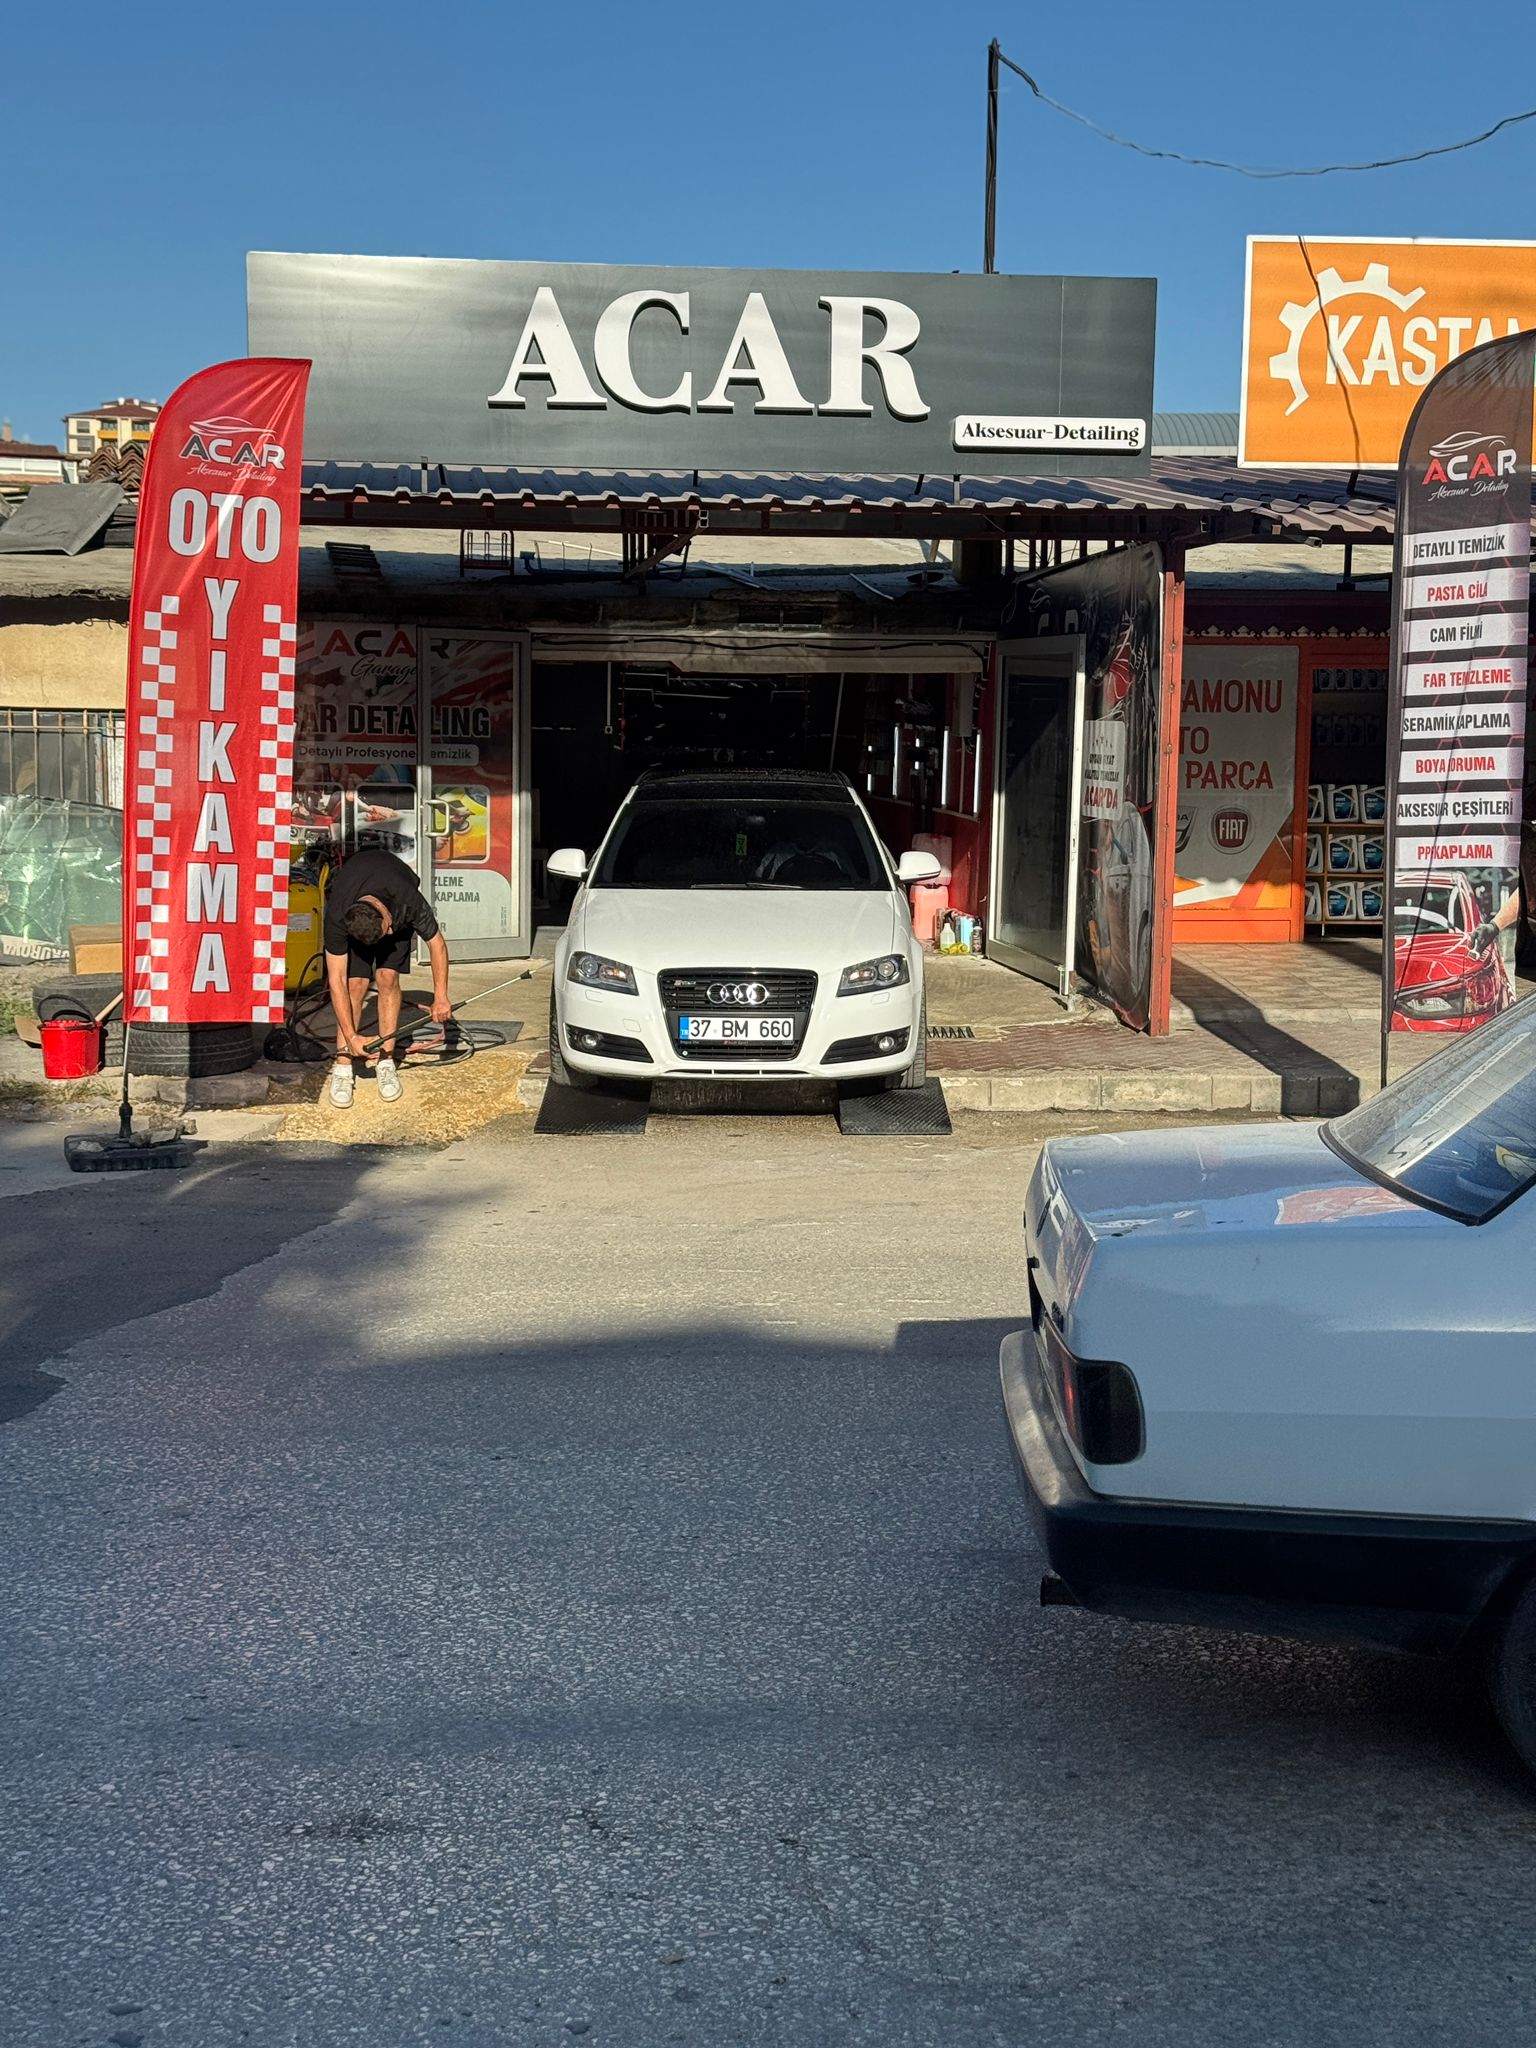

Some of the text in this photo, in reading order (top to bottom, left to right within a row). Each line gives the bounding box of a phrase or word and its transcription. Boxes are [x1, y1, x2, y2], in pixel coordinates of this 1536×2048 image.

[487, 286, 931, 423] ACAR
[962, 422, 1140, 447] Aksesuar-Detailing
[179, 434, 285, 470] ACAR
[1422, 449, 1517, 485] ACAR
[168, 488, 282, 563] OTO
[1413, 540, 1454, 559] DETAYLI
[1427, 584, 1464, 602] PASTA
[1430, 627, 1456, 643] CAM
[1423, 672, 1446, 688] FAR
[1181, 679, 1283, 713] AMONU
[348, 704, 492, 738] DETALING
[1403, 713, 1455, 732] SERAMİK
[346, 745, 416, 763] Profesyone
[430, 748, 472, 761] emizlik
[1415, 756, 1495, 774] BOYA ORUMA
[184, 576, 240, 993] YIKAMA
[1185, 760, 1274, 790] PARÇA
[1453, 798, 1513, 818] ÇEŞİTLERİ
[1219, 818, 1246, 840] FIAT
[690, 1020, 792, 1038] 37 BM 660
